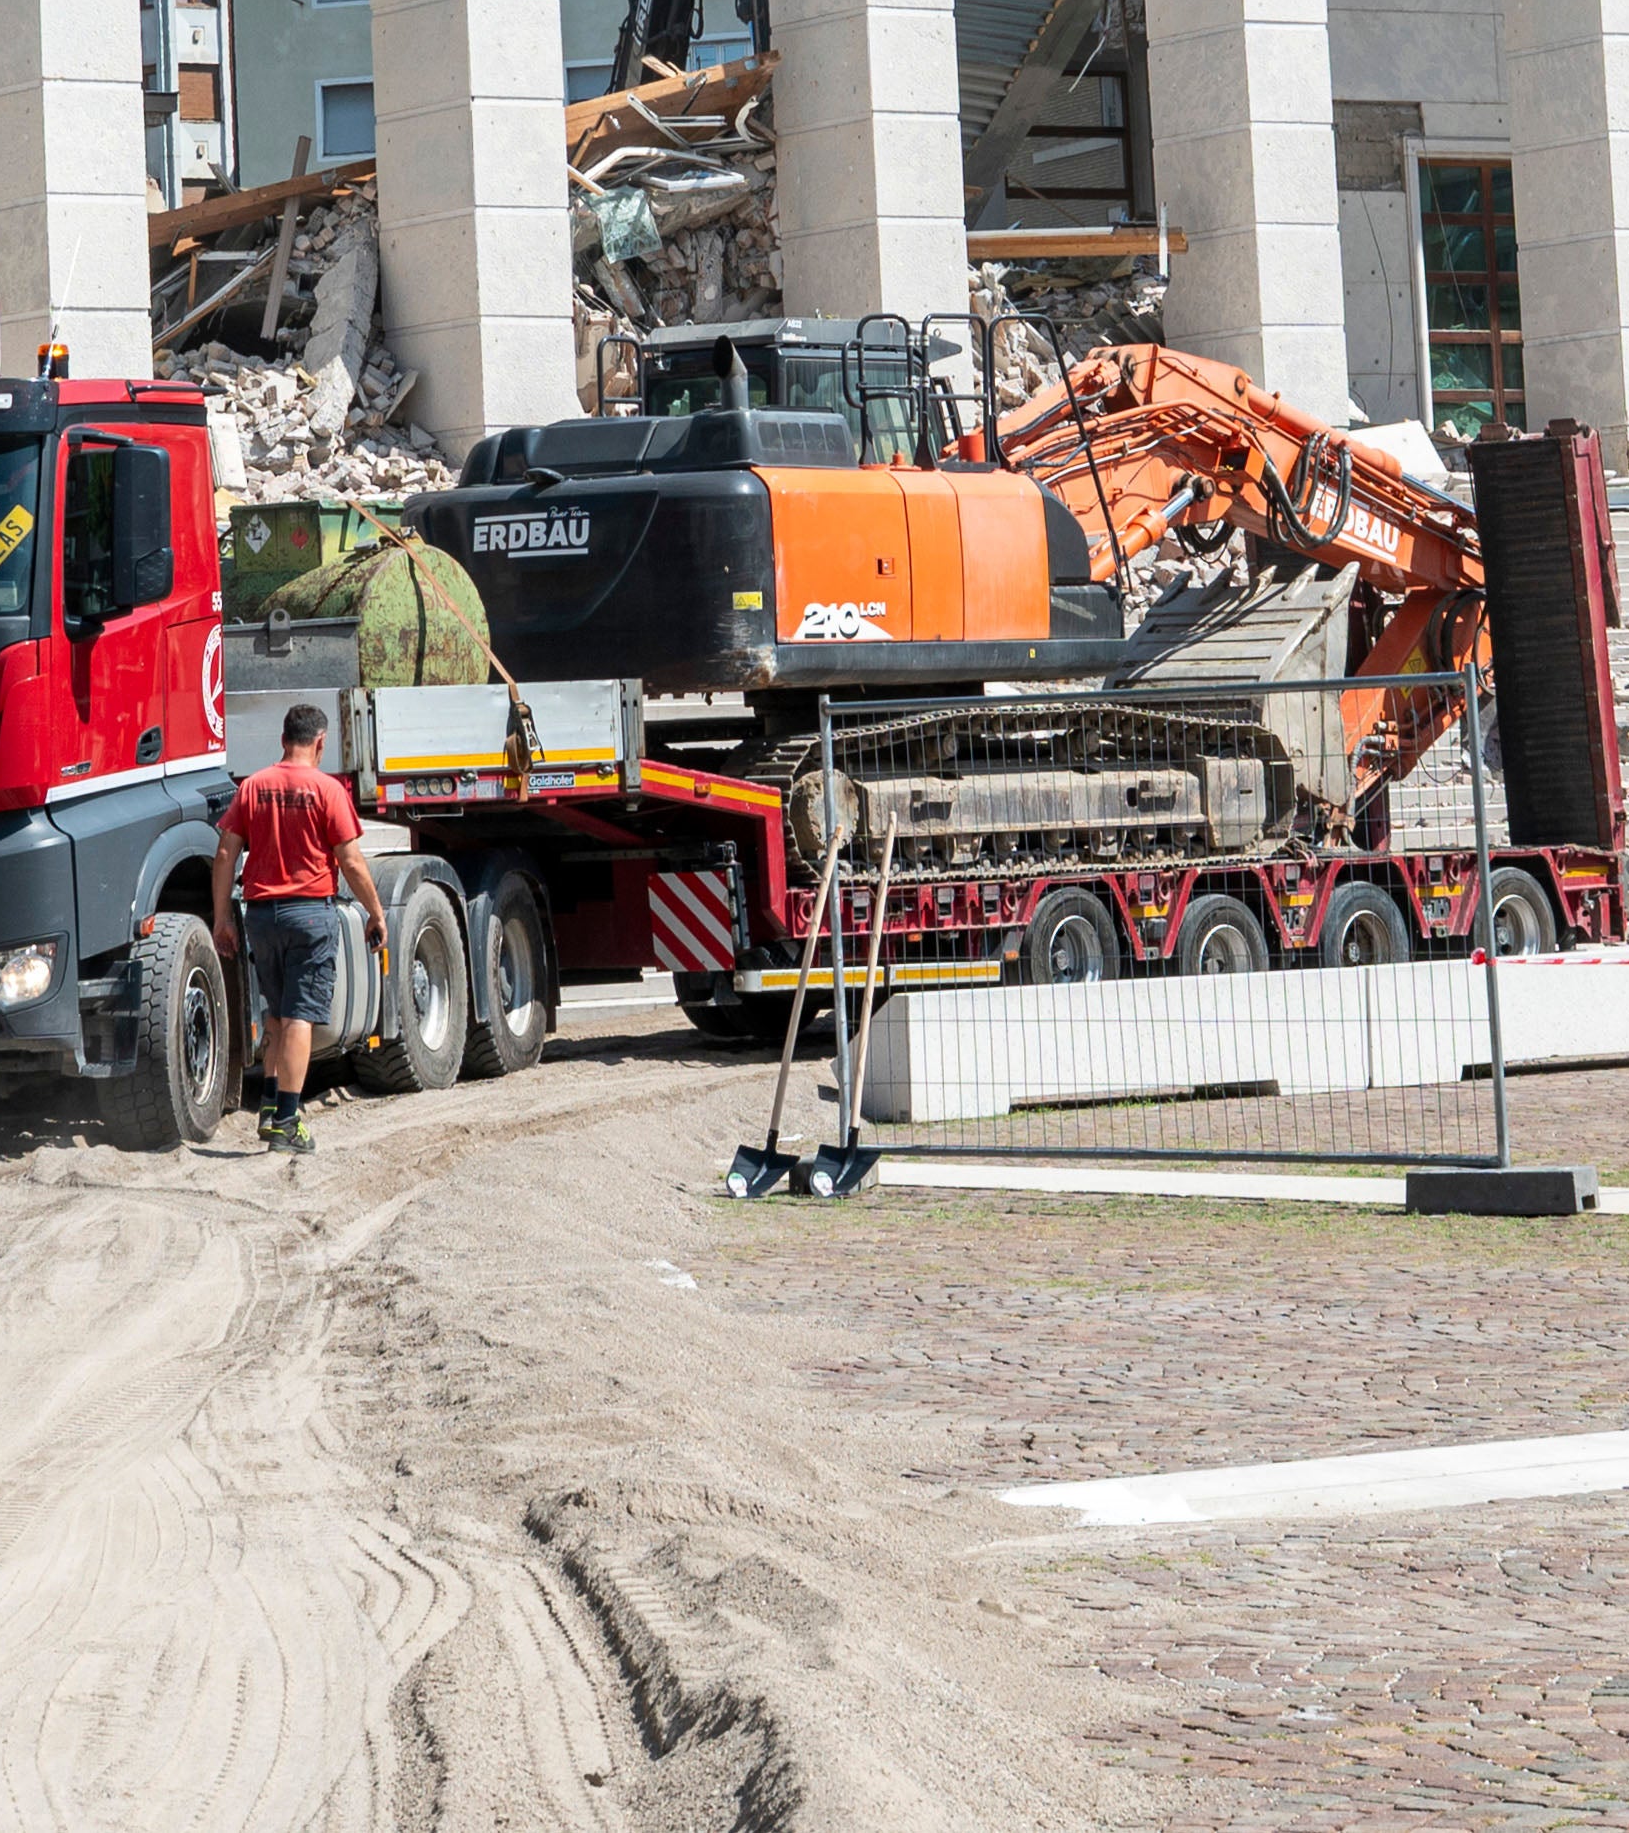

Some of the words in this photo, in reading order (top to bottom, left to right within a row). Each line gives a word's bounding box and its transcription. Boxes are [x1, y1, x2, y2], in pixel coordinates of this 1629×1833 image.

[473, 518, 590, 552] ERDBAU
[859, 601, 886, 618] LCN
[529, 775, 574, 787] Goldhofer
